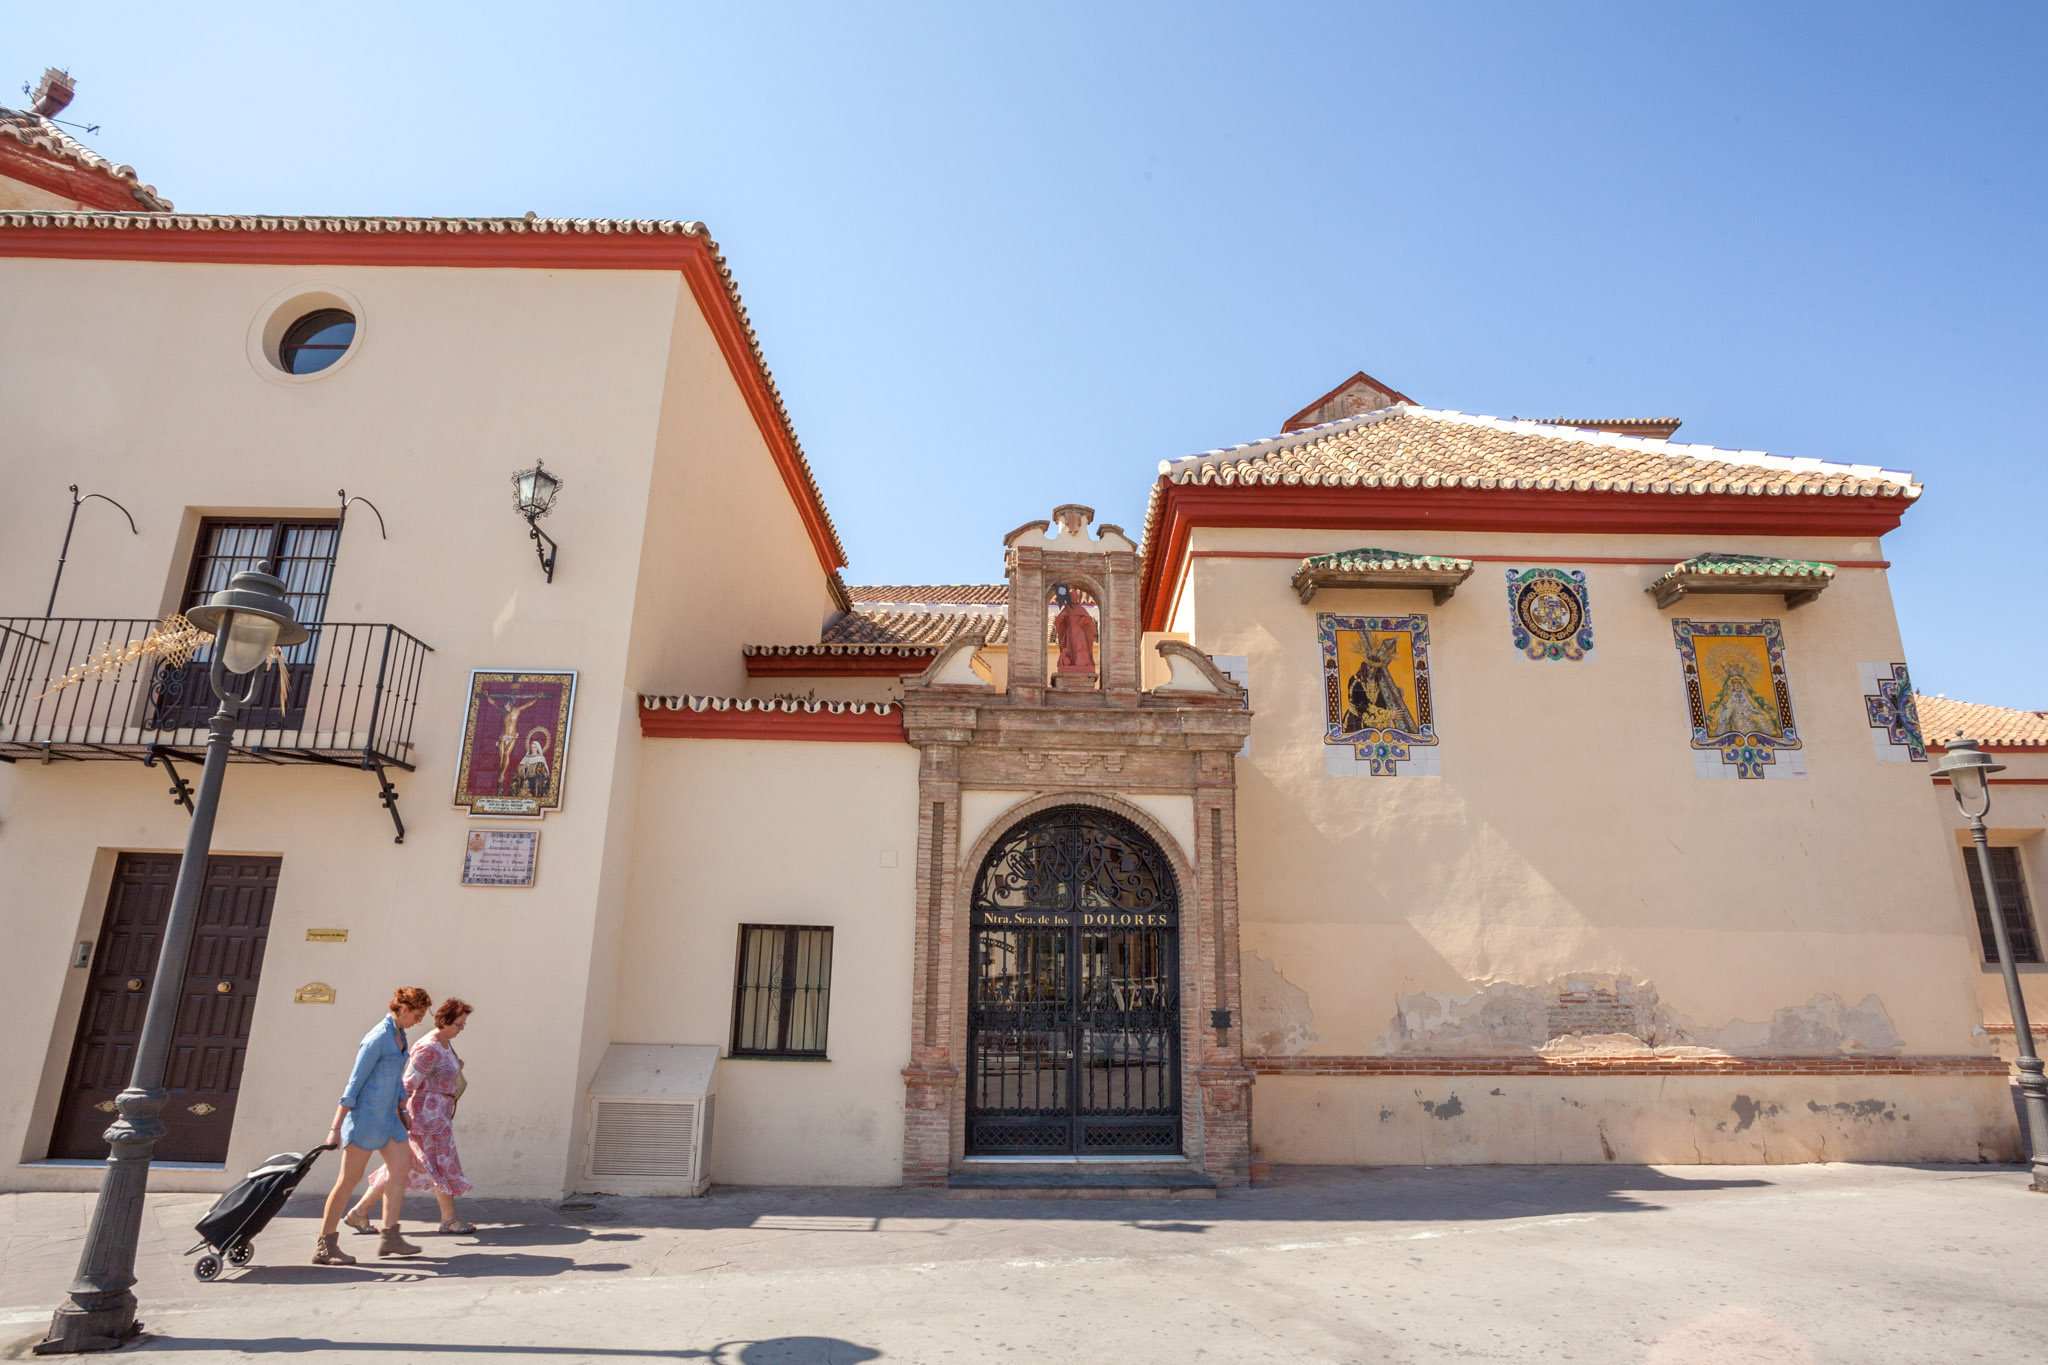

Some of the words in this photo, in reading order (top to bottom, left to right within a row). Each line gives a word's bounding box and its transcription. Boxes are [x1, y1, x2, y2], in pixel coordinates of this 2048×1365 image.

[984, 912, 1012, 924] Ntra.
[1014, 912, 1036, 925] Sra.
[1038, 914, 1050, 925] de
[1084, 914, 1167, 926] DOLORES
